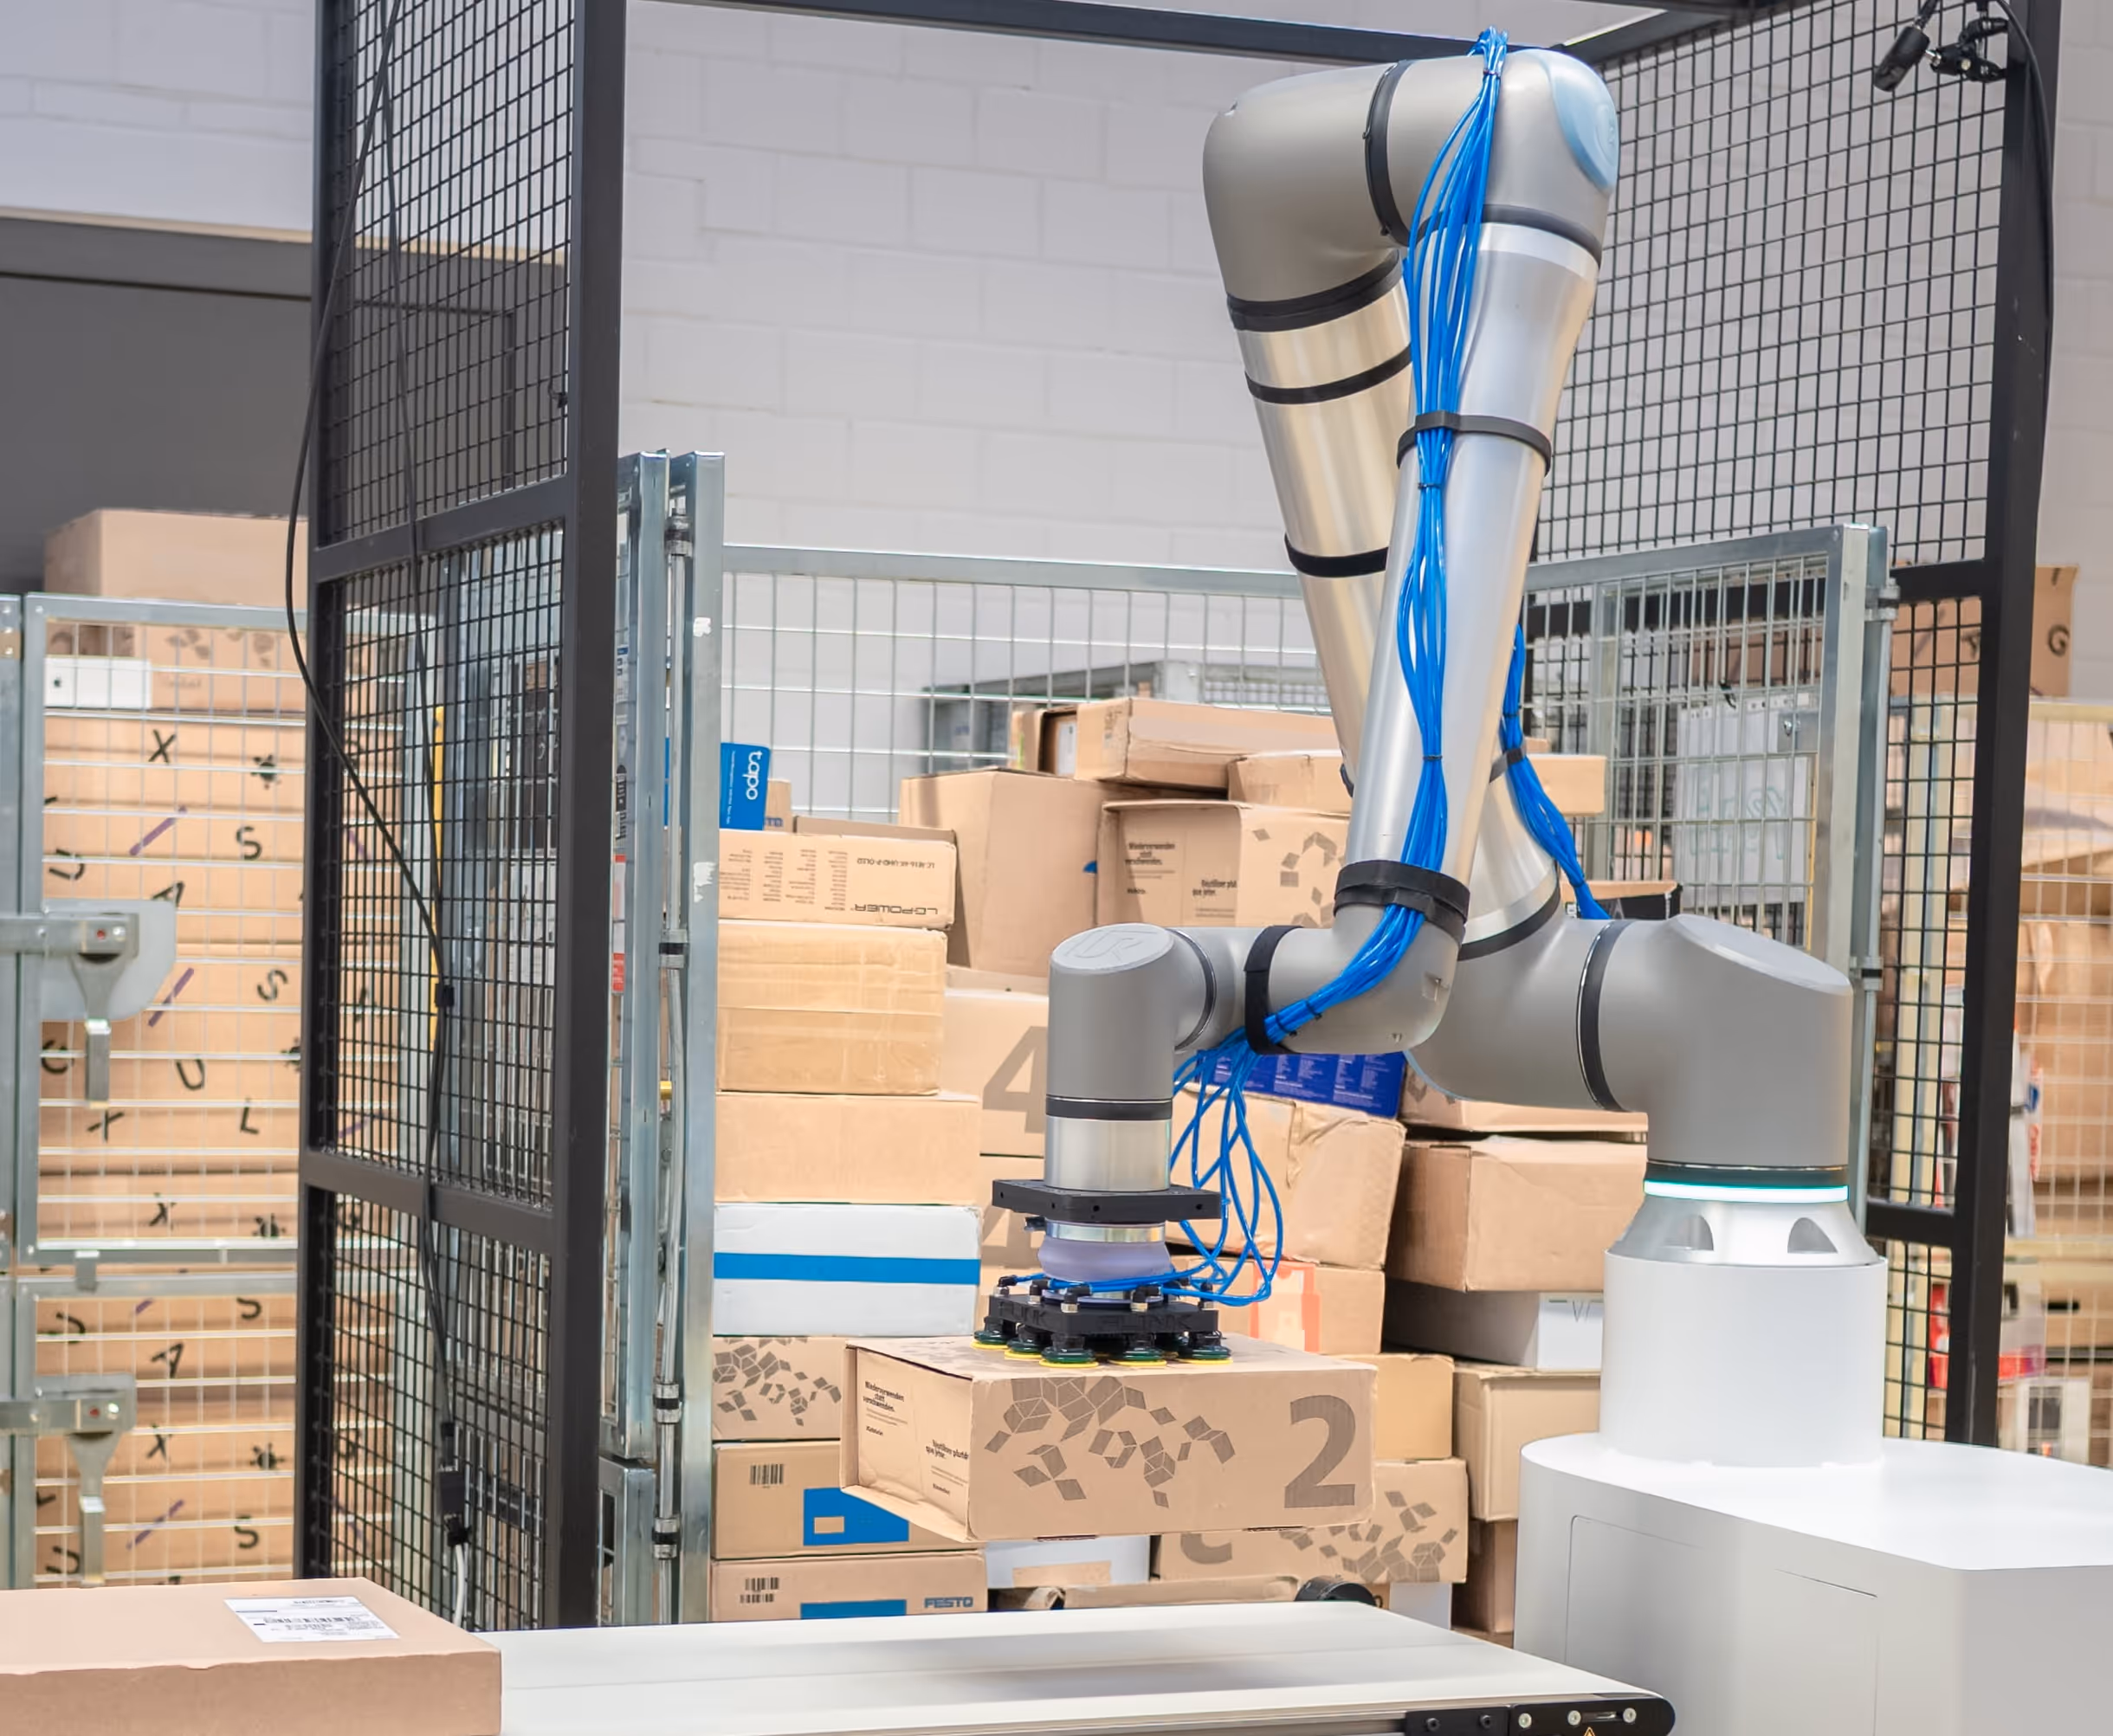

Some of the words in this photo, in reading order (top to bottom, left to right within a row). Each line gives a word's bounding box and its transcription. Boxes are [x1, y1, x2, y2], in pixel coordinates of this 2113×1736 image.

[2046, 624, 2071, 656] G
[742, 751, 762, 800] tapo
[236, 825, 262, 861] S
[983, 1026, 1047, 1134] 4
[1284, 1395, 1356, 1508] 2
[924, 1597, 973, 1608] FESTO
